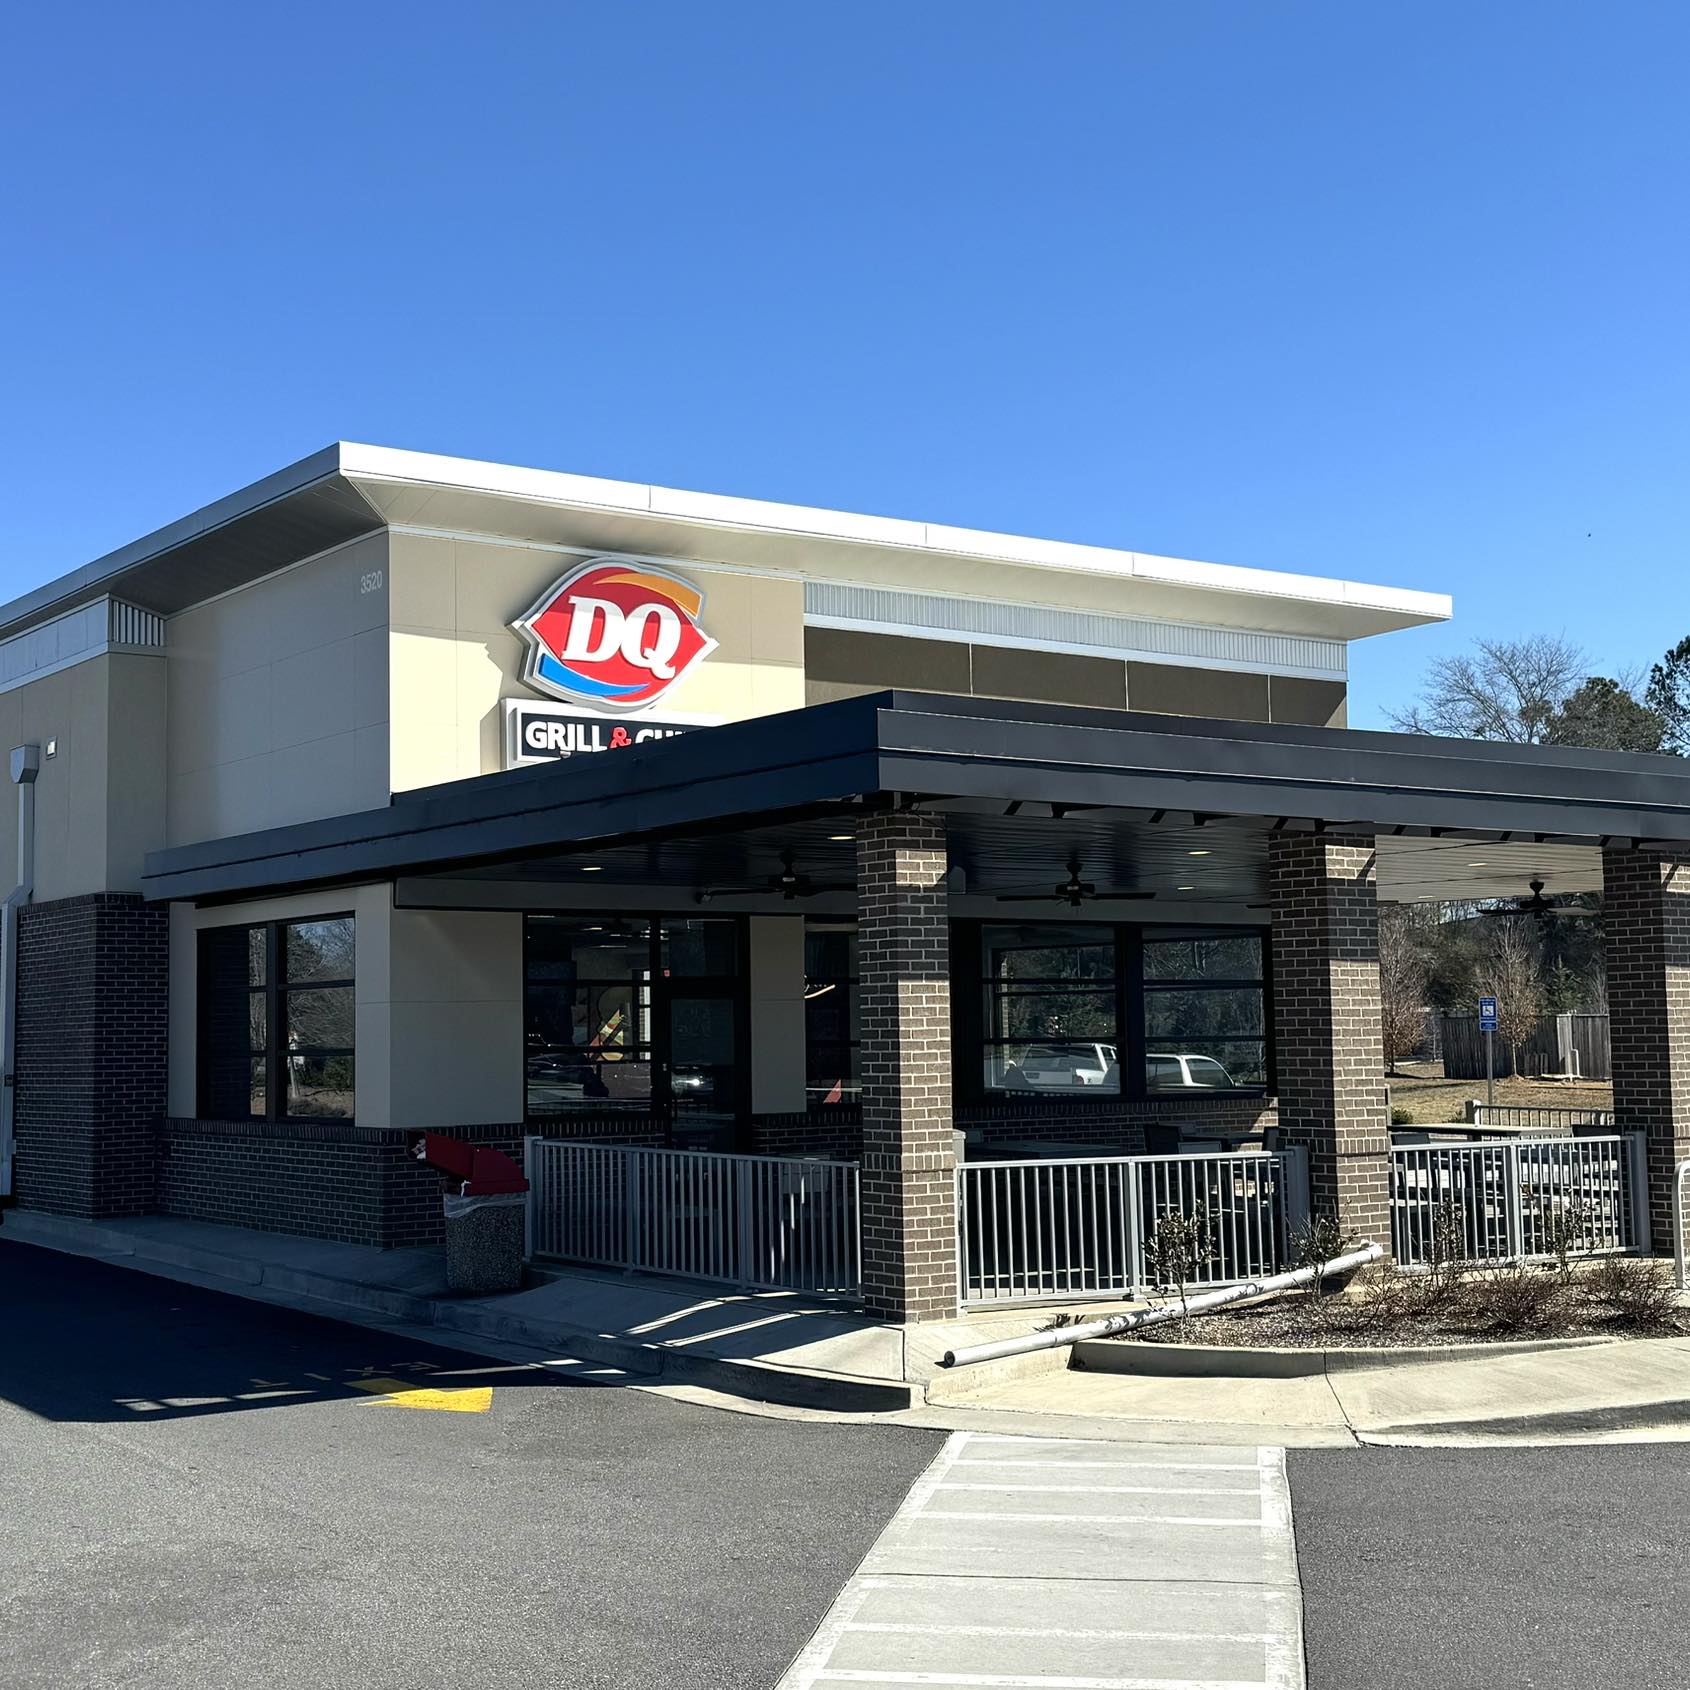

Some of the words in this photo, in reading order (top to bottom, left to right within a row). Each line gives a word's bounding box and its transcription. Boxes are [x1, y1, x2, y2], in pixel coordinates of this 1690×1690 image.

[360, 570, 383, 594] 3520
[560, 595, 682, 680] DQ
[525, 720, 608, 753] GRILL
[609, 726, 632, 749] &
